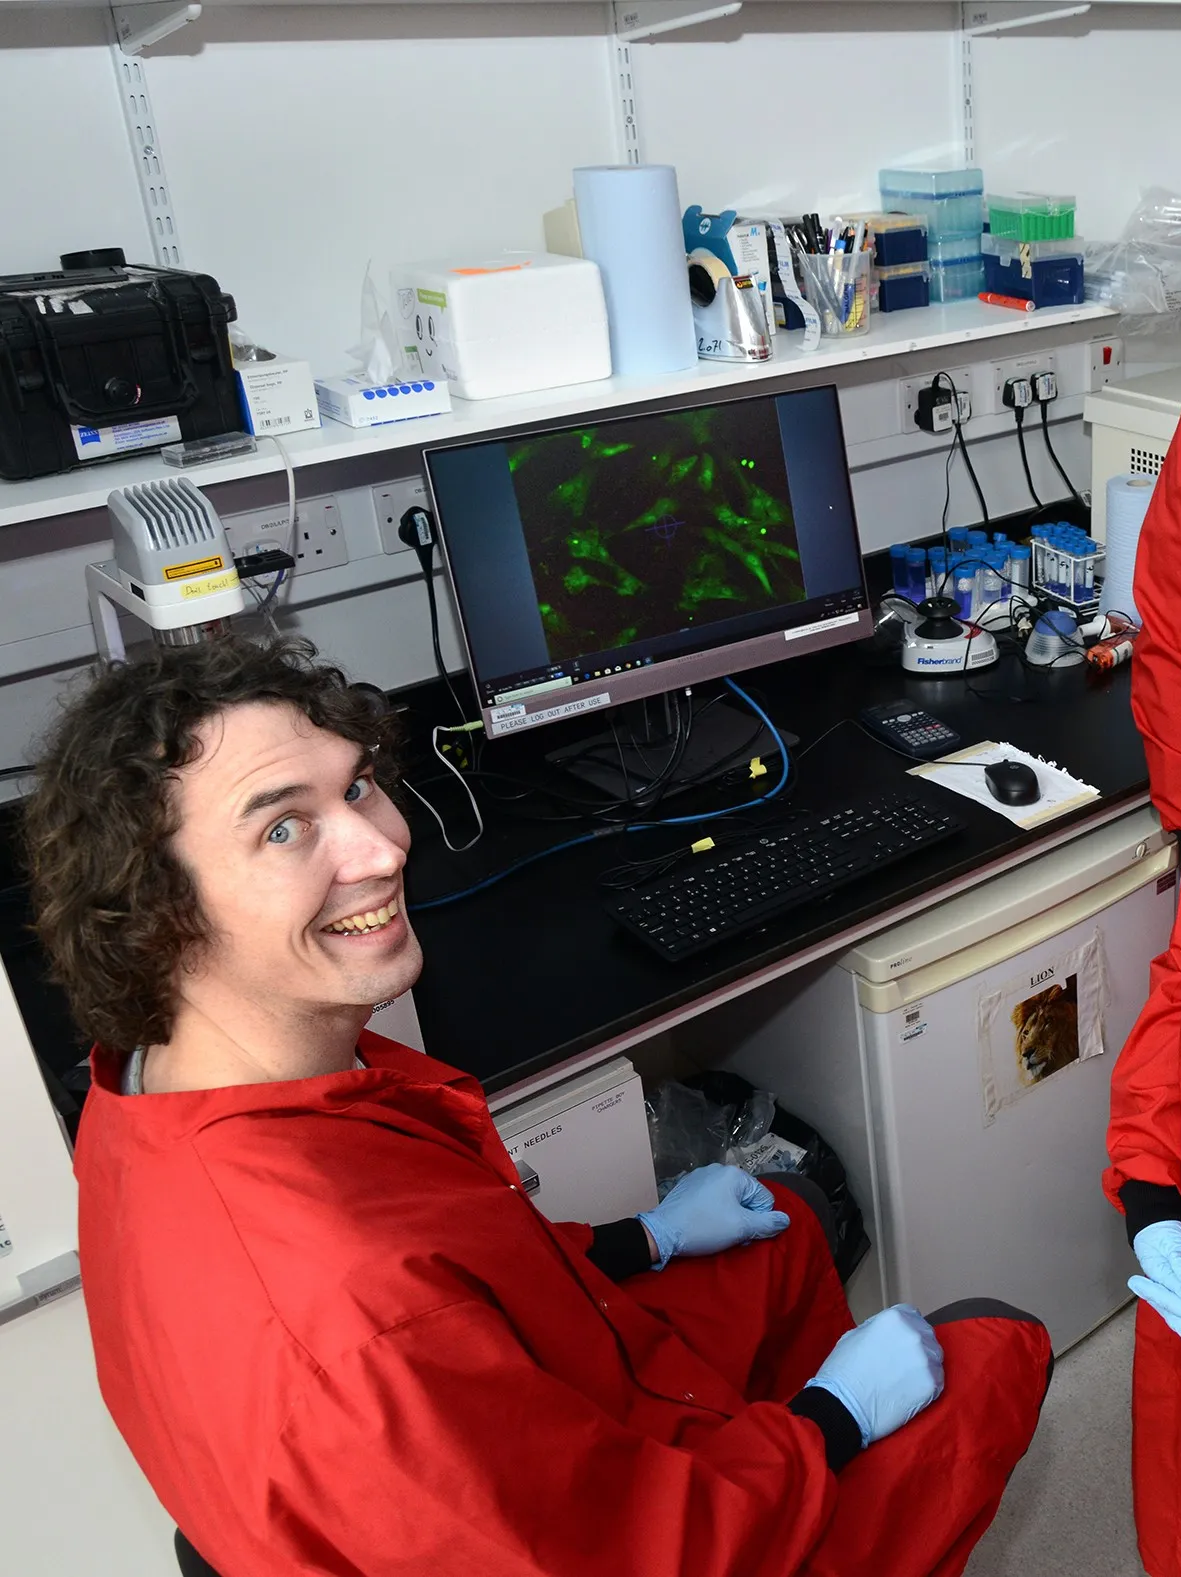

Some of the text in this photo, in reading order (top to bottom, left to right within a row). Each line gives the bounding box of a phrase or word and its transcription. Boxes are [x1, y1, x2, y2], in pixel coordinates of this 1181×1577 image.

[917, 657, 962, 665] Fisherbrand
[501, 717, 527, 730] PLEASE
[531, 713, 545, 723] LOG
[548, 709, 560, 718] OUT
[564, 702, 586, 713] AFTER
[589, 698, 601, 707] USE
[1030, 966, 1055, 986] LION
[524, 1124, 563, 1149] NEEDLES
